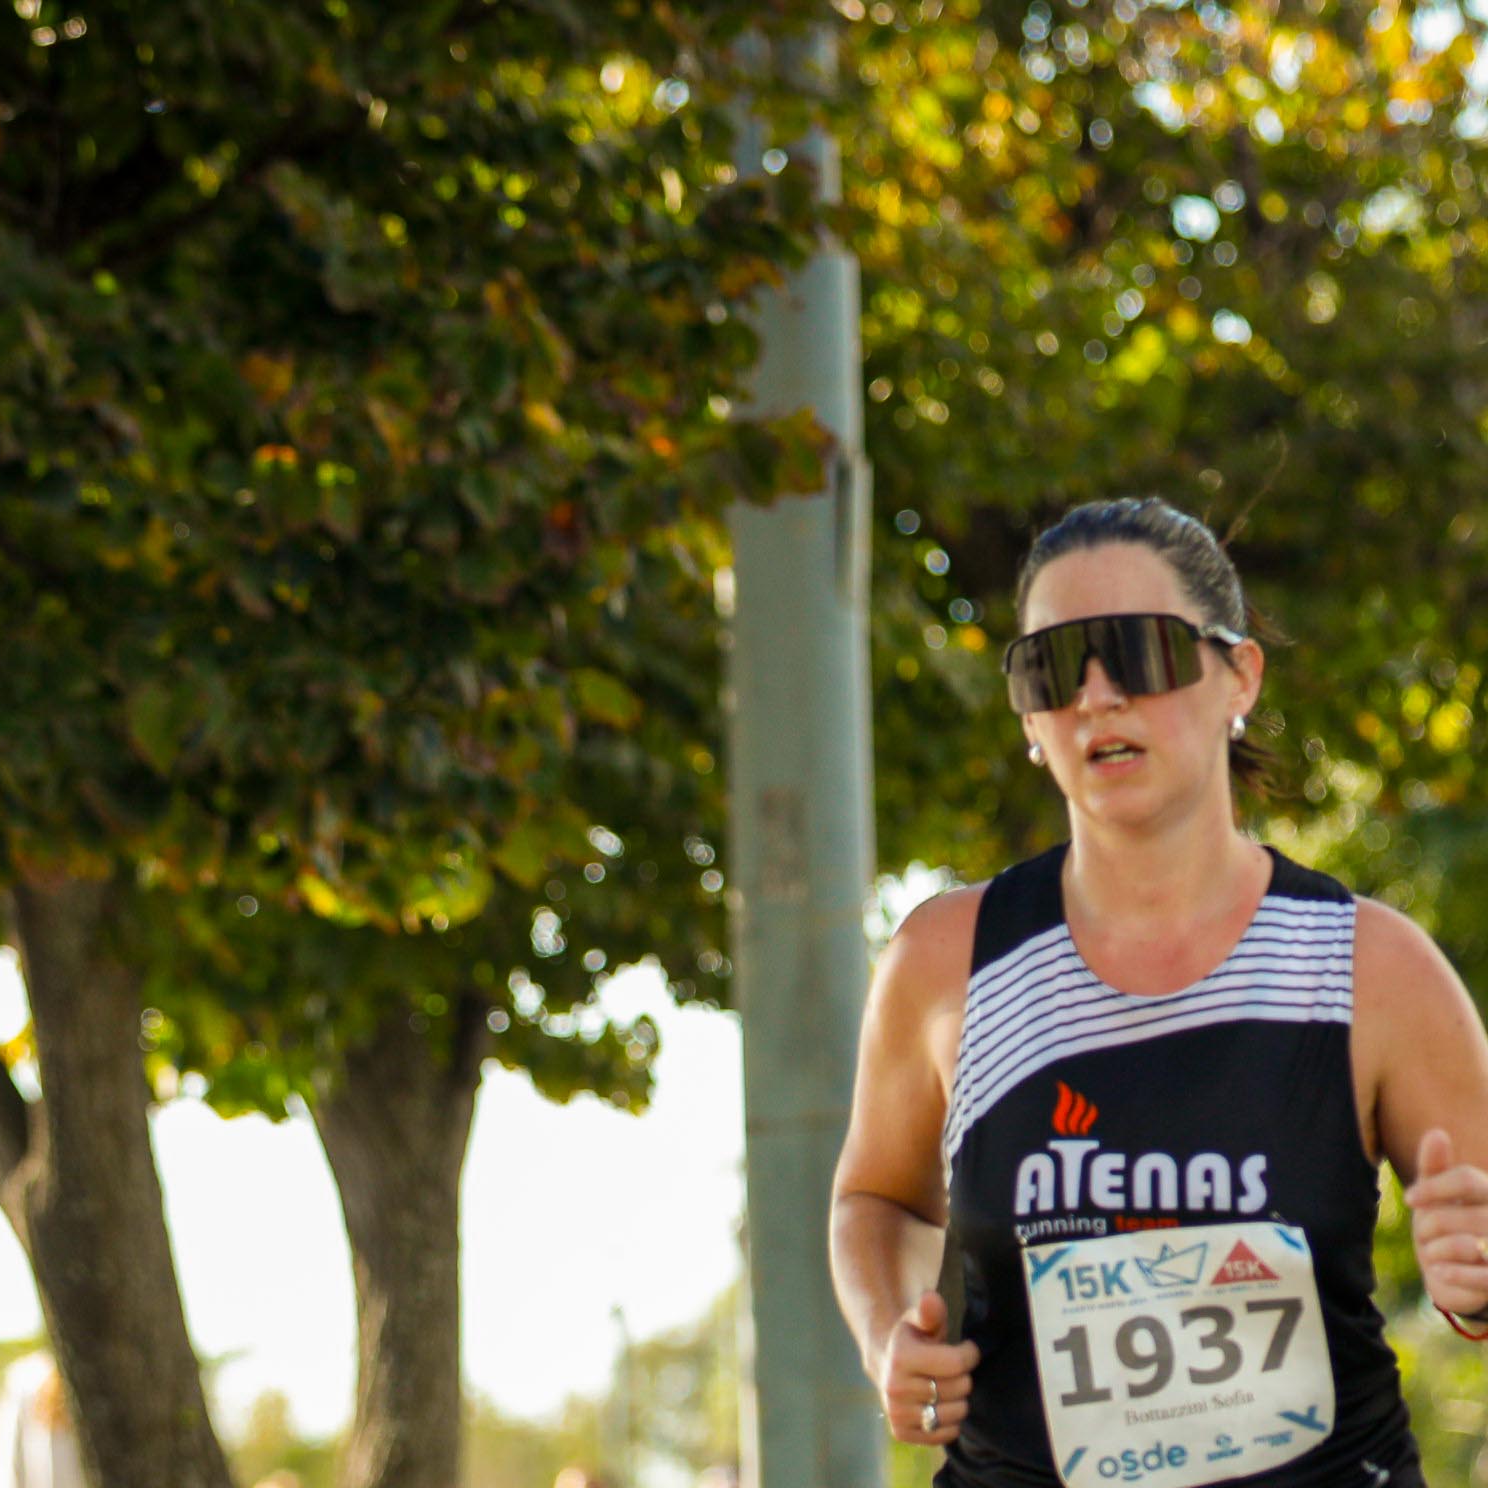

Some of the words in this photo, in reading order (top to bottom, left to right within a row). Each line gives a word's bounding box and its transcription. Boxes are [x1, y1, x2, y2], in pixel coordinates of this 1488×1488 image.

[1015, 1139, 1268, 1217] ATENAS
[1015, 1214, 1107, 1239] running
[1114, 1215, 1180, 1232] team
[1057, 1260, 1132, 1301] 15K
[1224, 1260, 1264, 1279] 15K
[1053, 1296, 1304, 1407] 1937
[1098, 1441, 1187, 1481] osde
